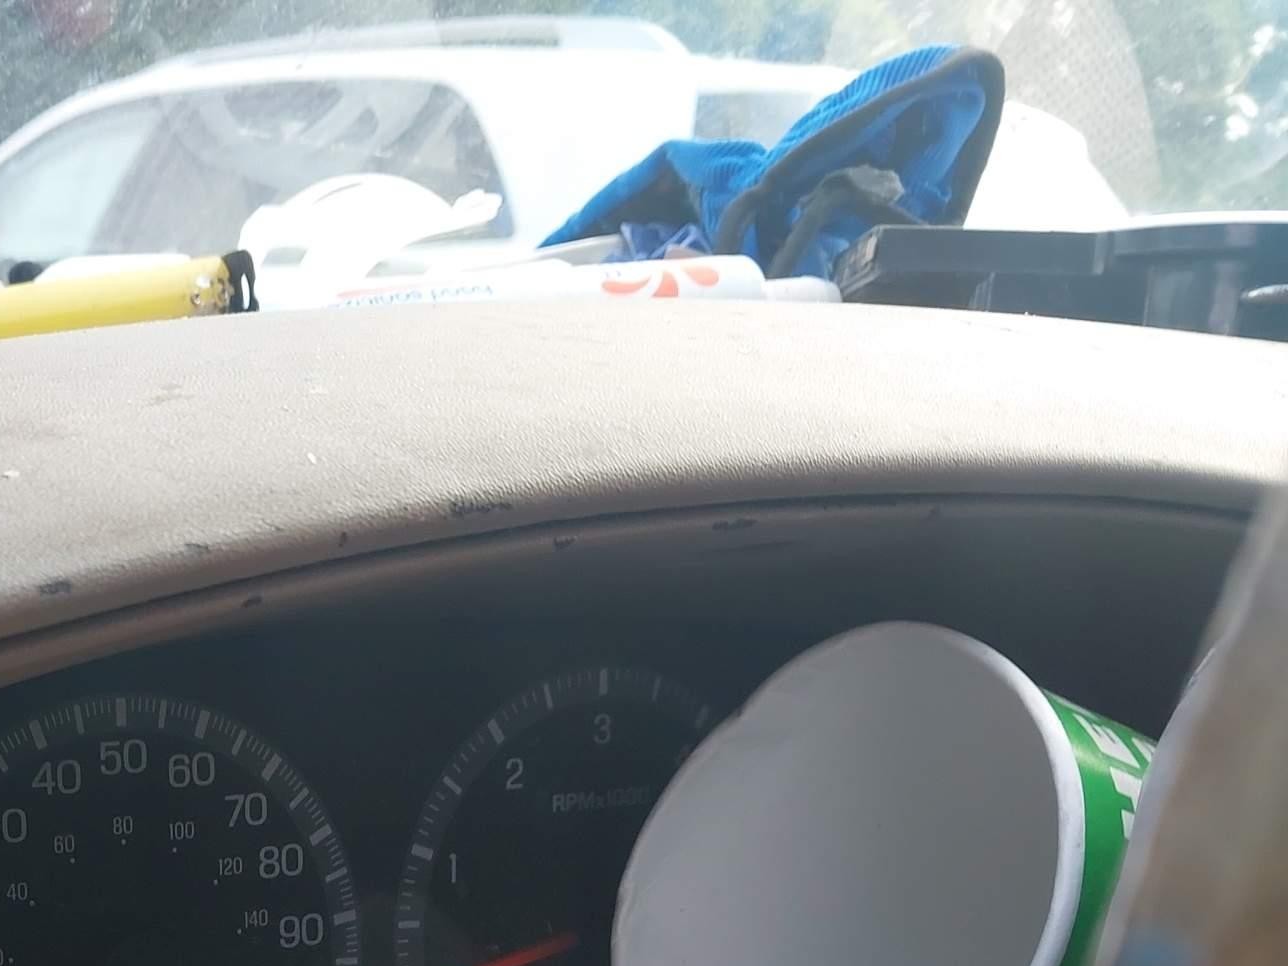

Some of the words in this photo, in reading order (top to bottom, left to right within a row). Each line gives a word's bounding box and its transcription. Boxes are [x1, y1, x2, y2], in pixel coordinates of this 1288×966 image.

[592, 713, 613, 744] 3
[98, 739, 148, 775] 50
[168, 753, 215, 787] 60
[32, 759, 82, 796] 40
[505, 758, 525, 791] 2
[112, 816, 134, 836] 80
[224, 792, 268, 828] 70
[53, 835, 76, 854] 60
[168, 822, 195, 841] 100
[218, 857, 244, 876] 120
[258, 844, 304, 880] 80
[449, 852, 458, 884] 1
[6, 883, 29, 902] 40
[243, 909, 269, 929] 140
[278, 913, 324, 949] 90
